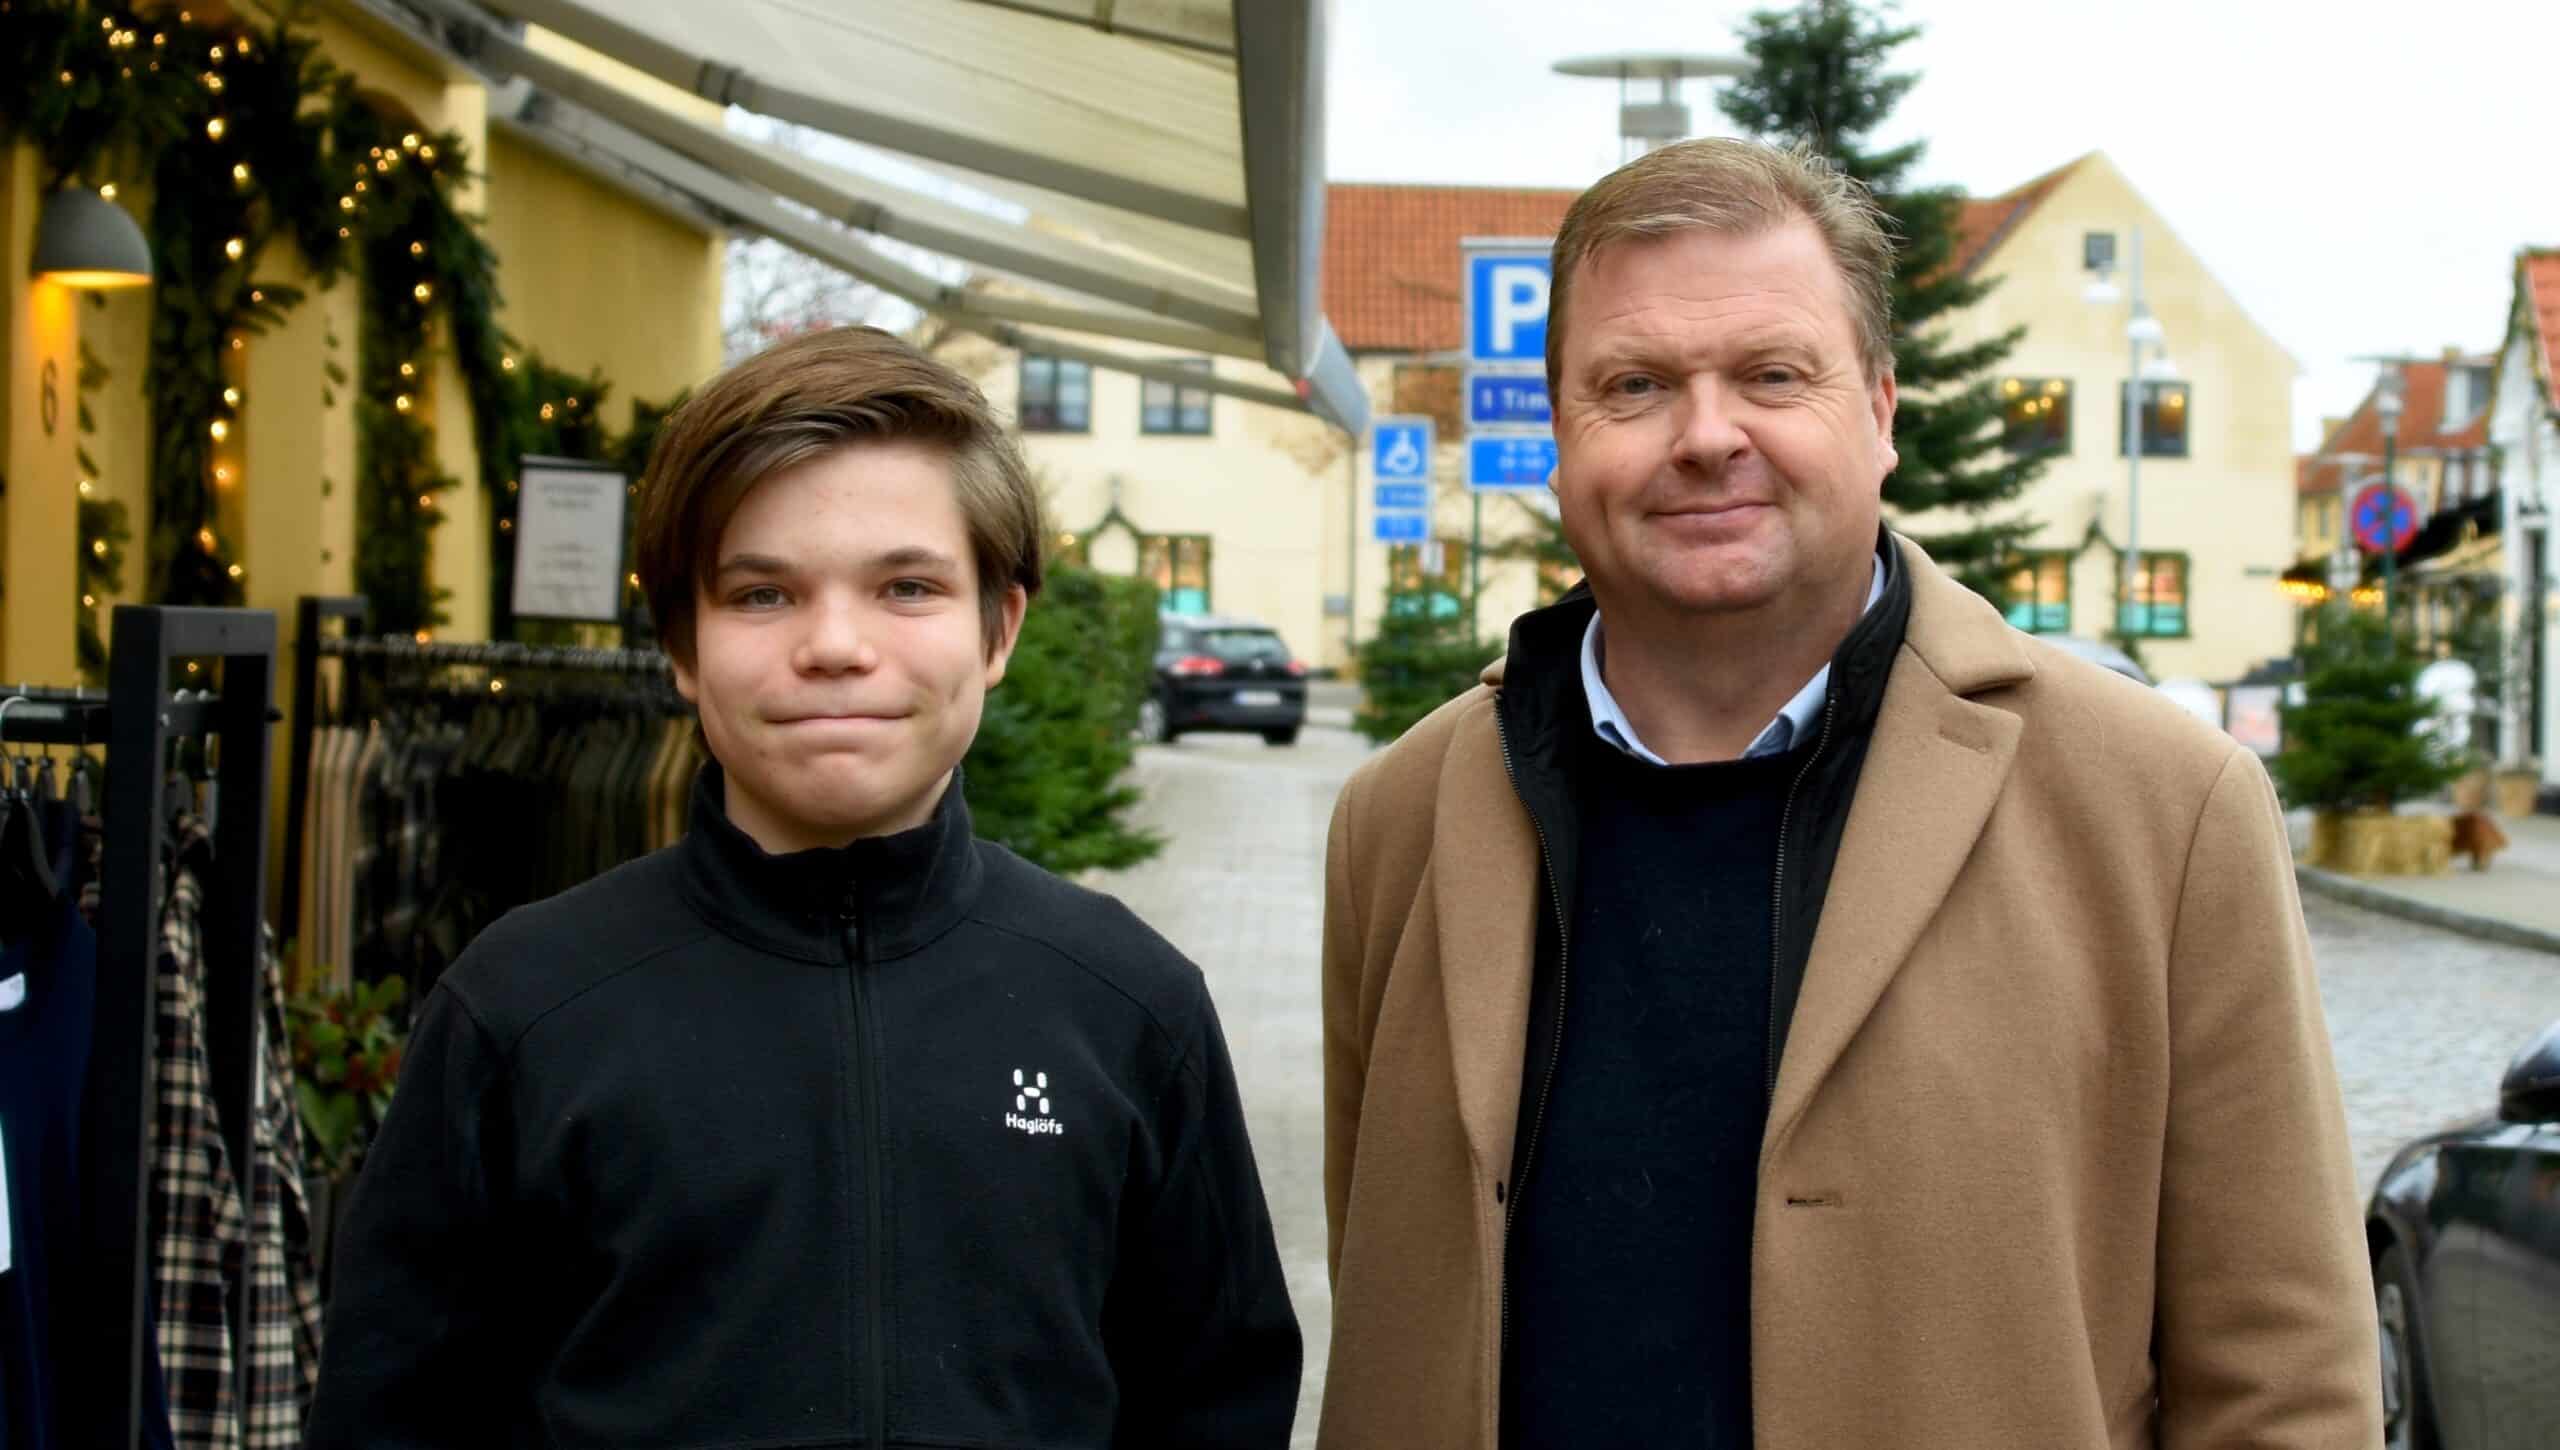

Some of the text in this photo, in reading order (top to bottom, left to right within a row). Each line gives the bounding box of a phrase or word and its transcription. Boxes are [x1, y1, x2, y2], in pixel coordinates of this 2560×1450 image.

[1492, 265, 1551, 352] P
[40, 357, 58, 438] 6
[1005, 1111, 1064, 1135] Haglöfs
